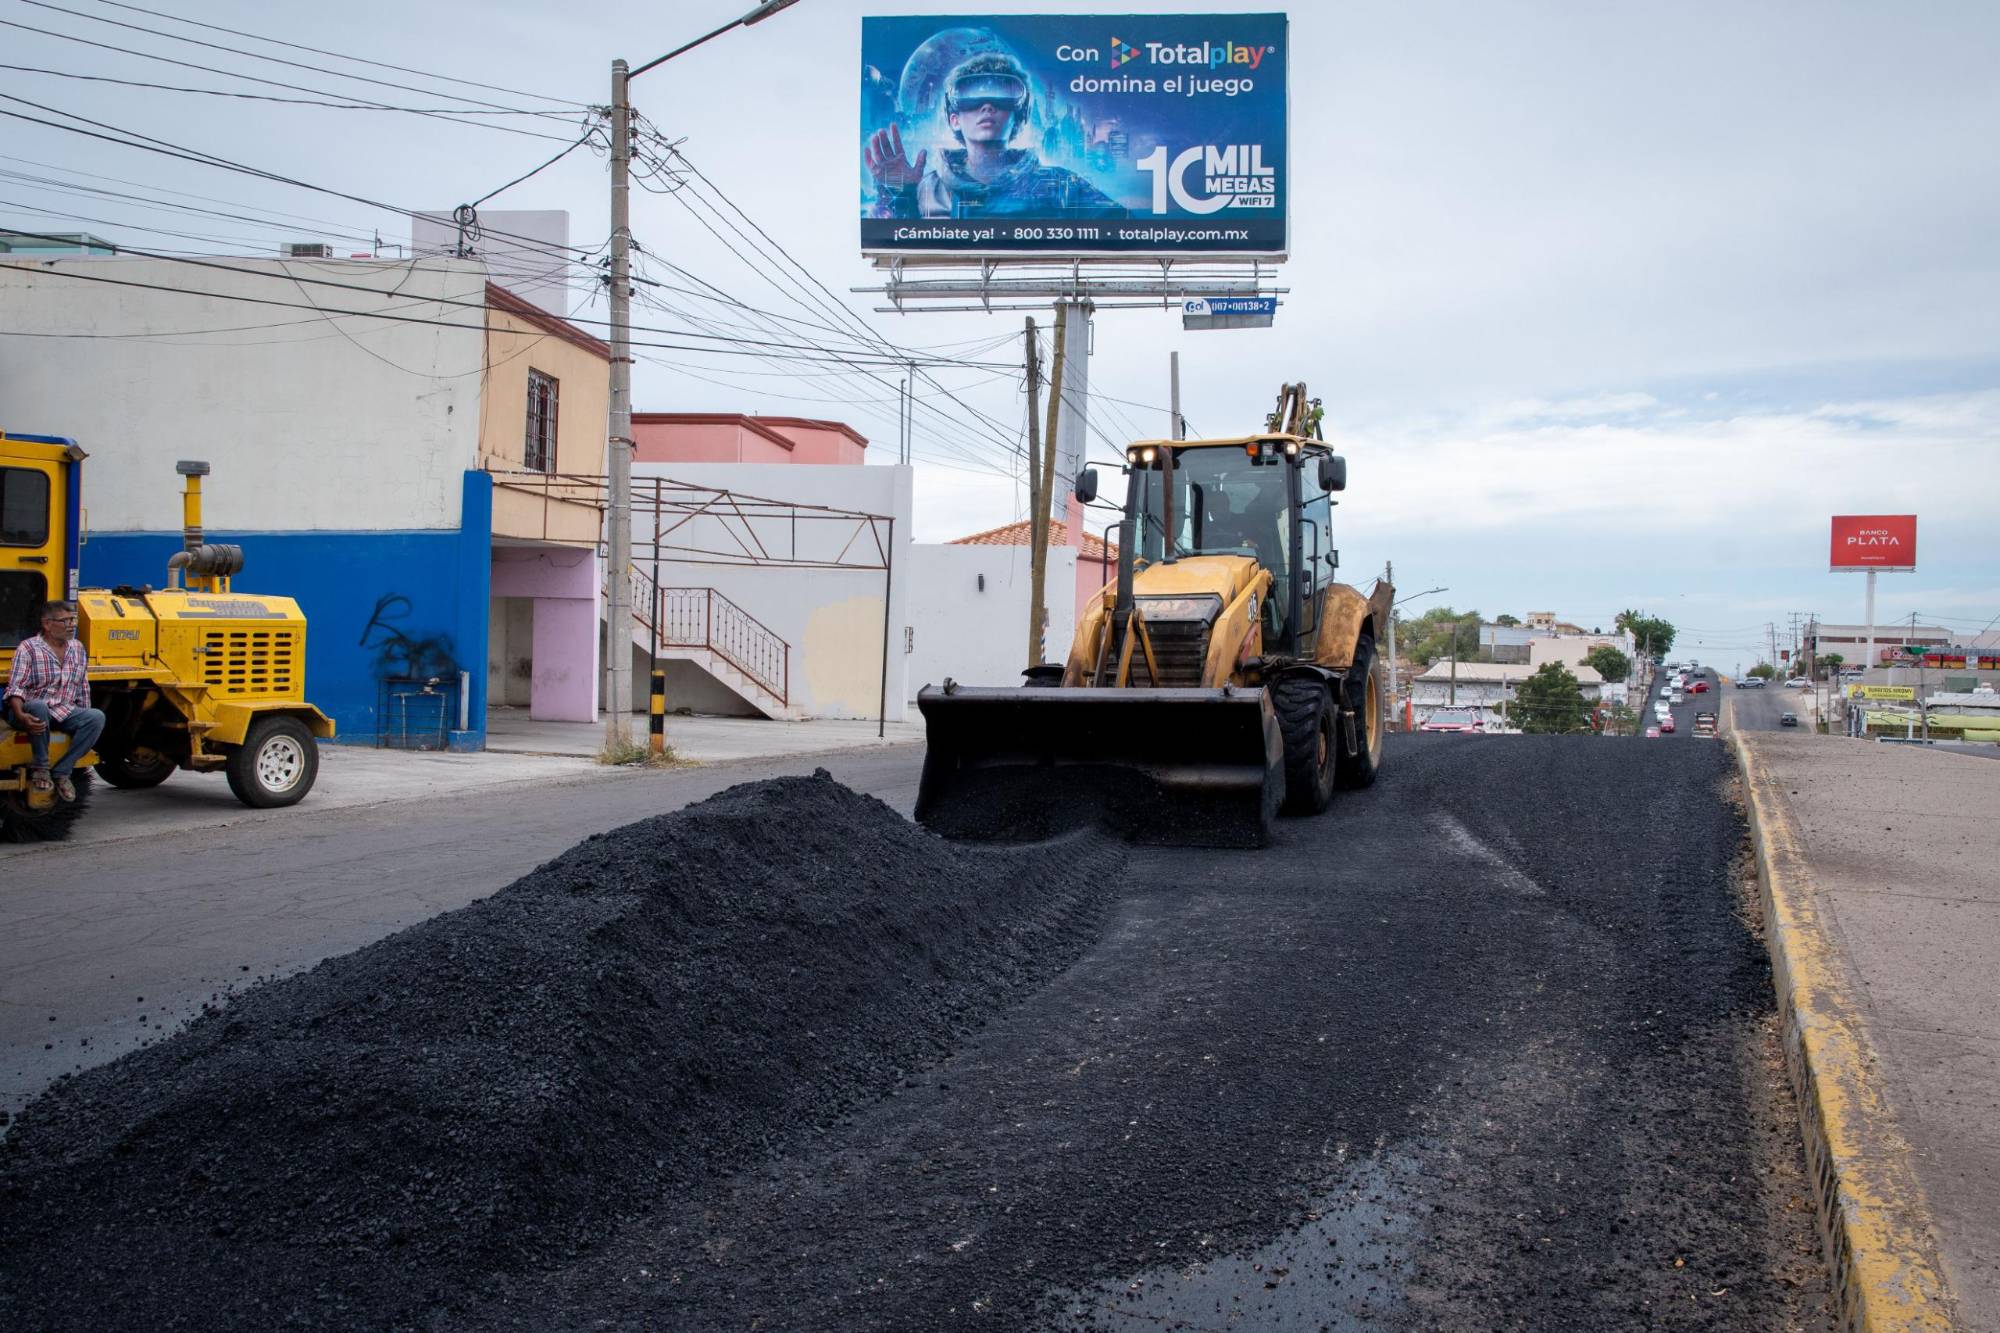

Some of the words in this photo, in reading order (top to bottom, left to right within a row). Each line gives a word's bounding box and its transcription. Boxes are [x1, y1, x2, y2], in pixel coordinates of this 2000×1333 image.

[1056, 45, 1099, 62] Con
[1070, 75, 1156, 93] domina
[1163, 76, 1182, 93] el
[1187, 76, 1254, 96] juego
[1205, 144, 1275, 176] MIL
[1136, 145, 1235, 214] 10
[1205, 177, 1275, 193] MEGAS
[1238, 197, 1262, 205] WIFI
[1264, 197, 1272, 205] 7
[894, 227, 969, 241] ¡Cámbiate
[973, 228, 994, 242] ya!
[1014, 228, 1042, 239] 800
[1046, 228, 1073, 239] 330
[1077, 228, 1099, 239] 1111
[1119, 228, 1248, 242] totalplay.com.mx
[1847, 536, 1899, 545] PLATA
